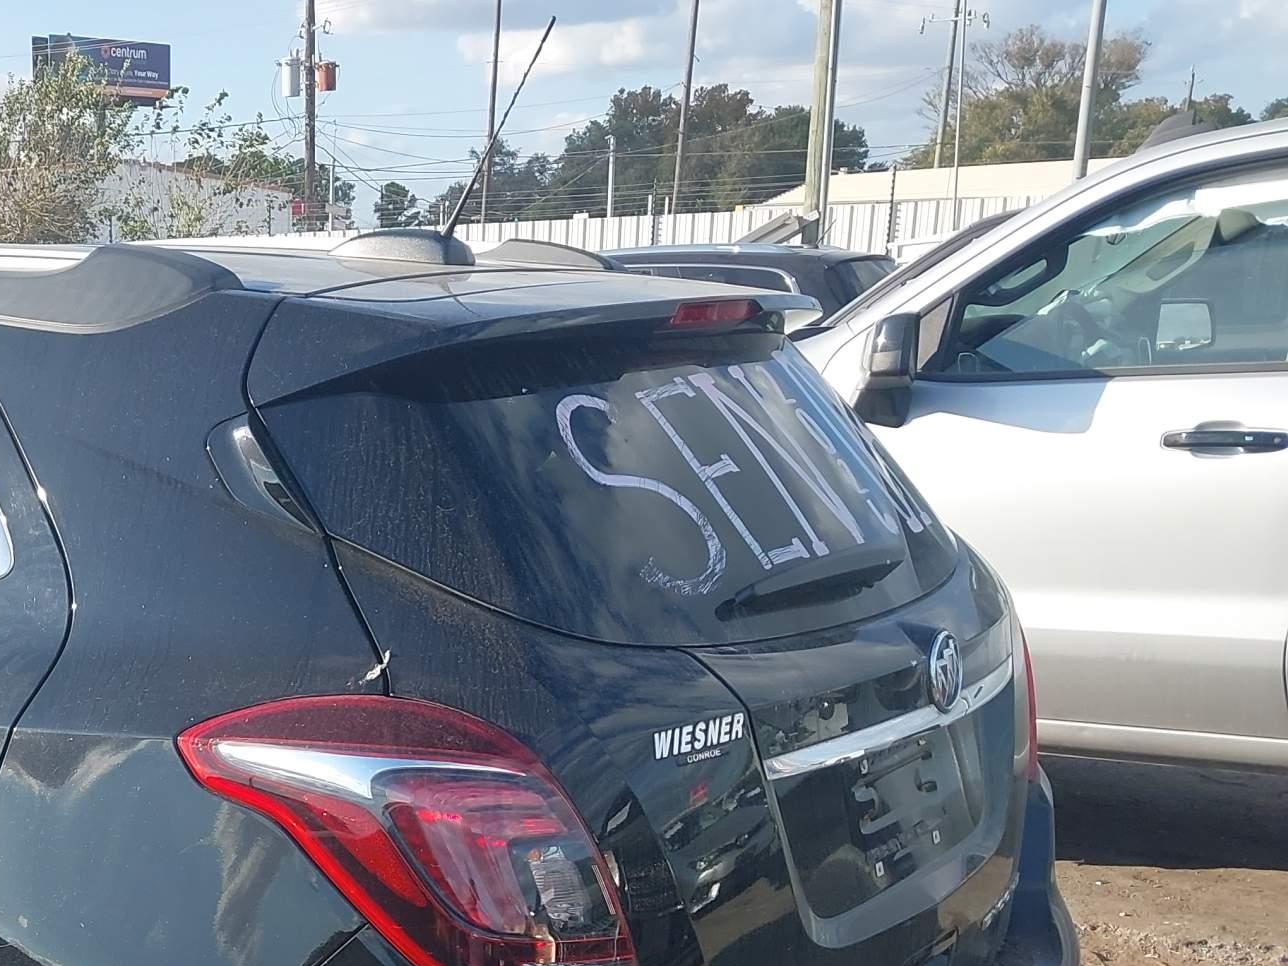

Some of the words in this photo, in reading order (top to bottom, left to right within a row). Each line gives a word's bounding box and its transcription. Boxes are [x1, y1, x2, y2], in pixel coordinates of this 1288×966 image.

[110, 46, 147, 60] centrum
[146, 70, 160, 80] Way
[653, 711, 745, 760] WIESNER
[686, 748, 722, 764] CONROE
